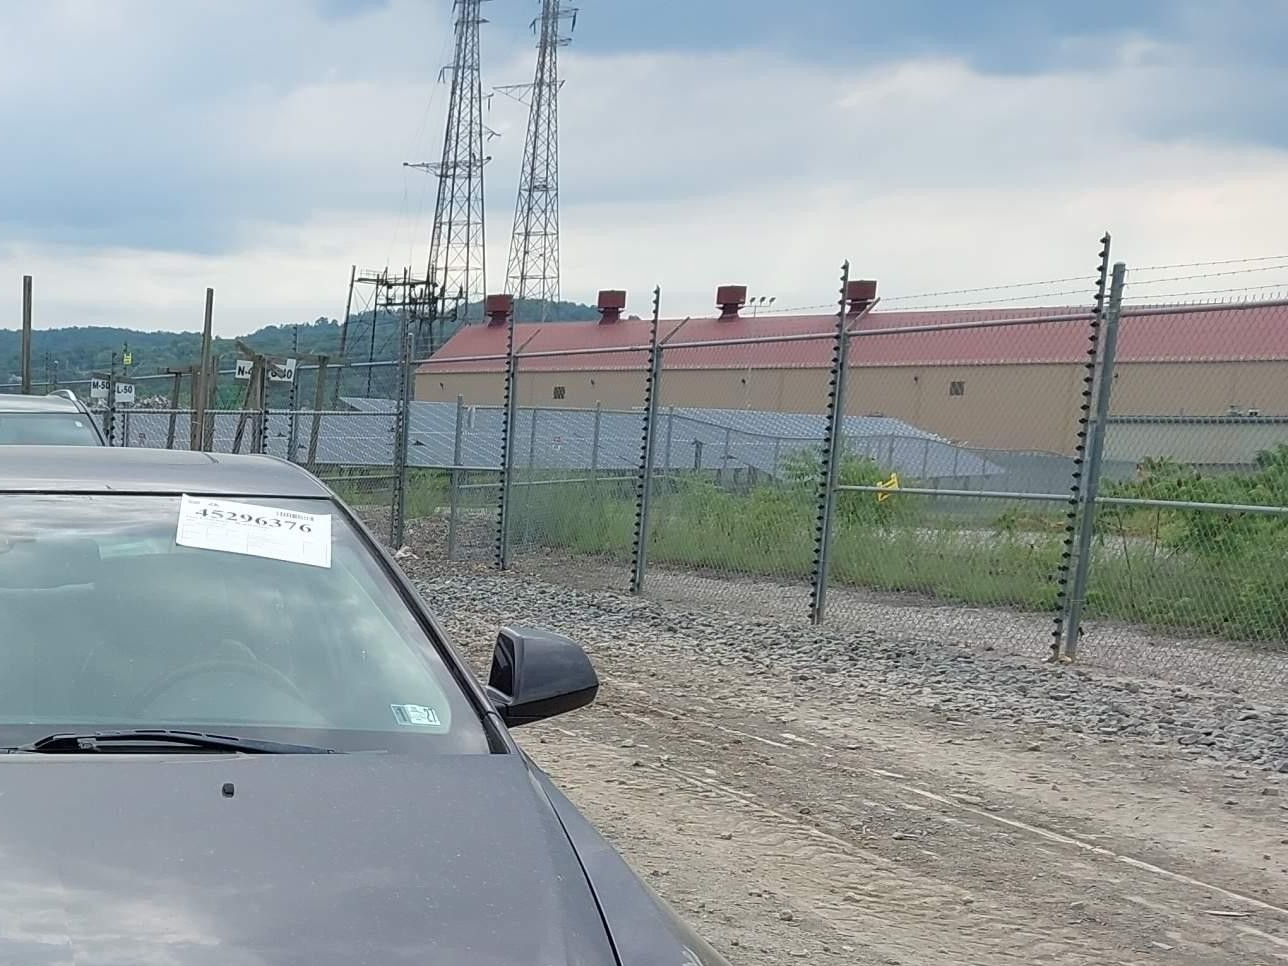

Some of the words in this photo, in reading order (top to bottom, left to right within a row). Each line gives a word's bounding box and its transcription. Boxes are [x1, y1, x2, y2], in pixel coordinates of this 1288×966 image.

[92, 380, 110, 390] M-50
[116, 385, 132, 394] L-50
[195, 508, 312, 533] 45296376
